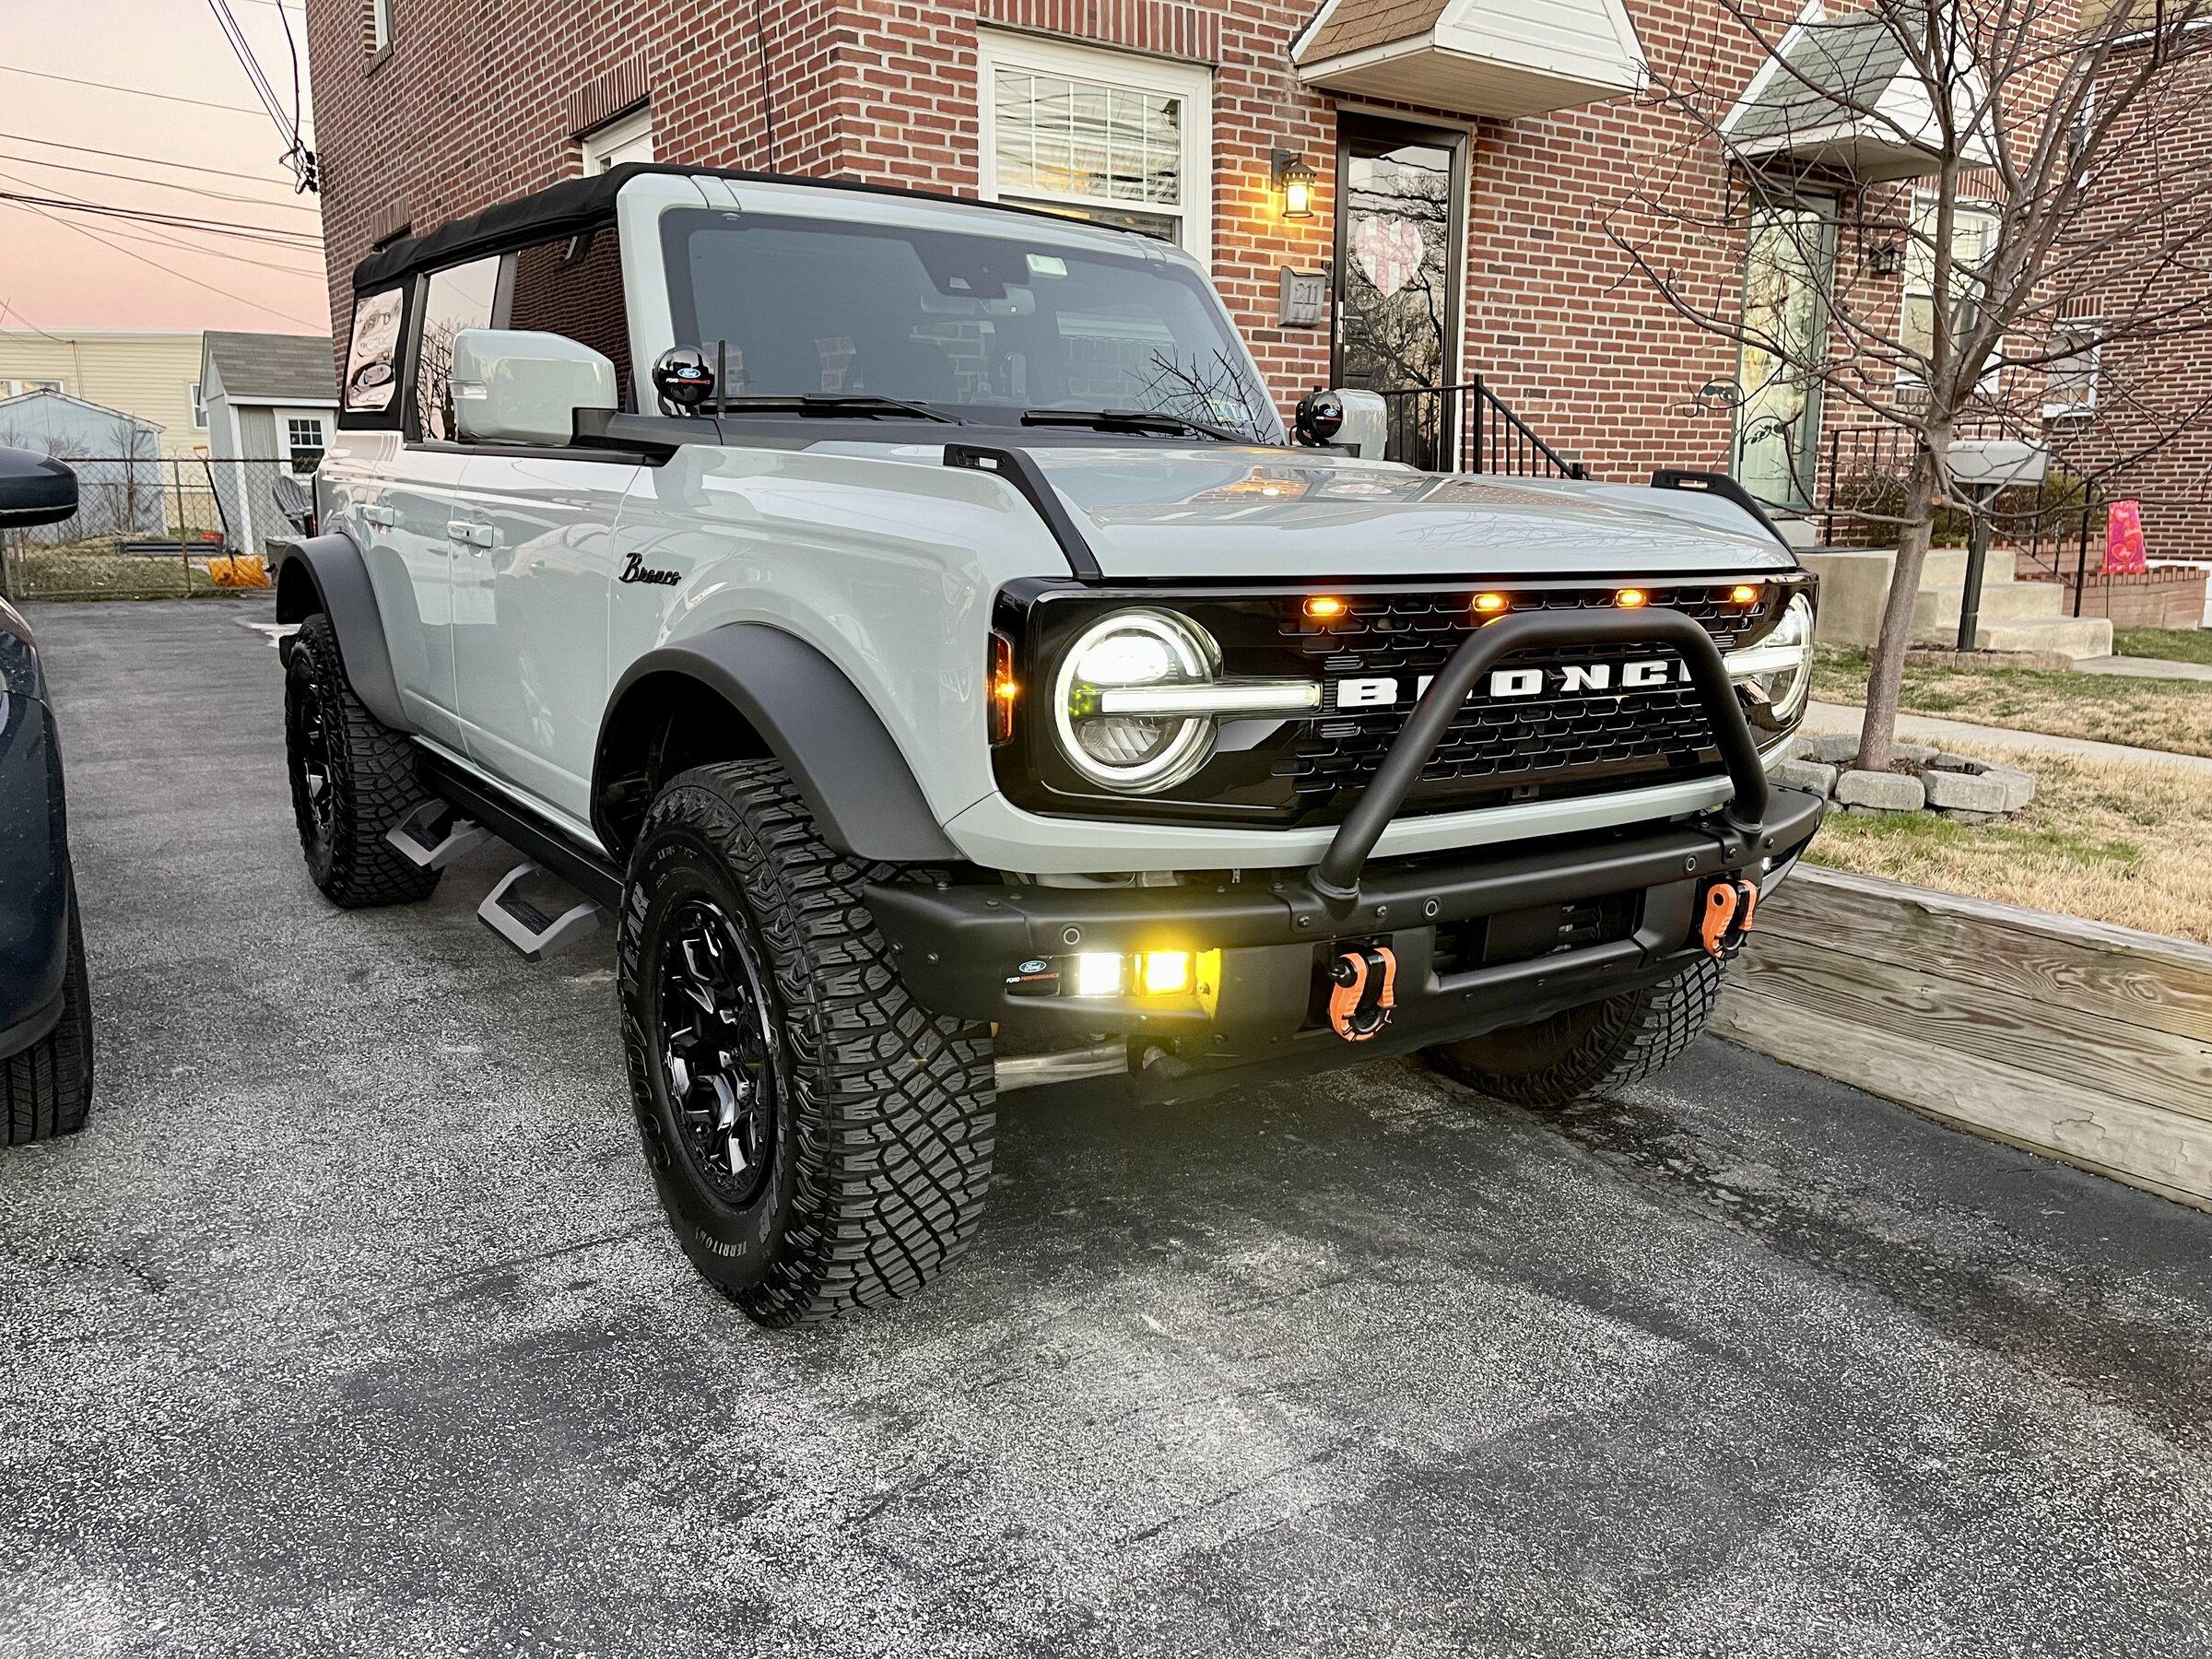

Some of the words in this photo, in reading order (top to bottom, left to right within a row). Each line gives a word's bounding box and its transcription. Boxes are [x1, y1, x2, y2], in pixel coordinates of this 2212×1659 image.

[1293, 282, 1319, 305] 211
[618, 553, 682, 586] Bronco
[1336, 659, 1692, 708] BONC
